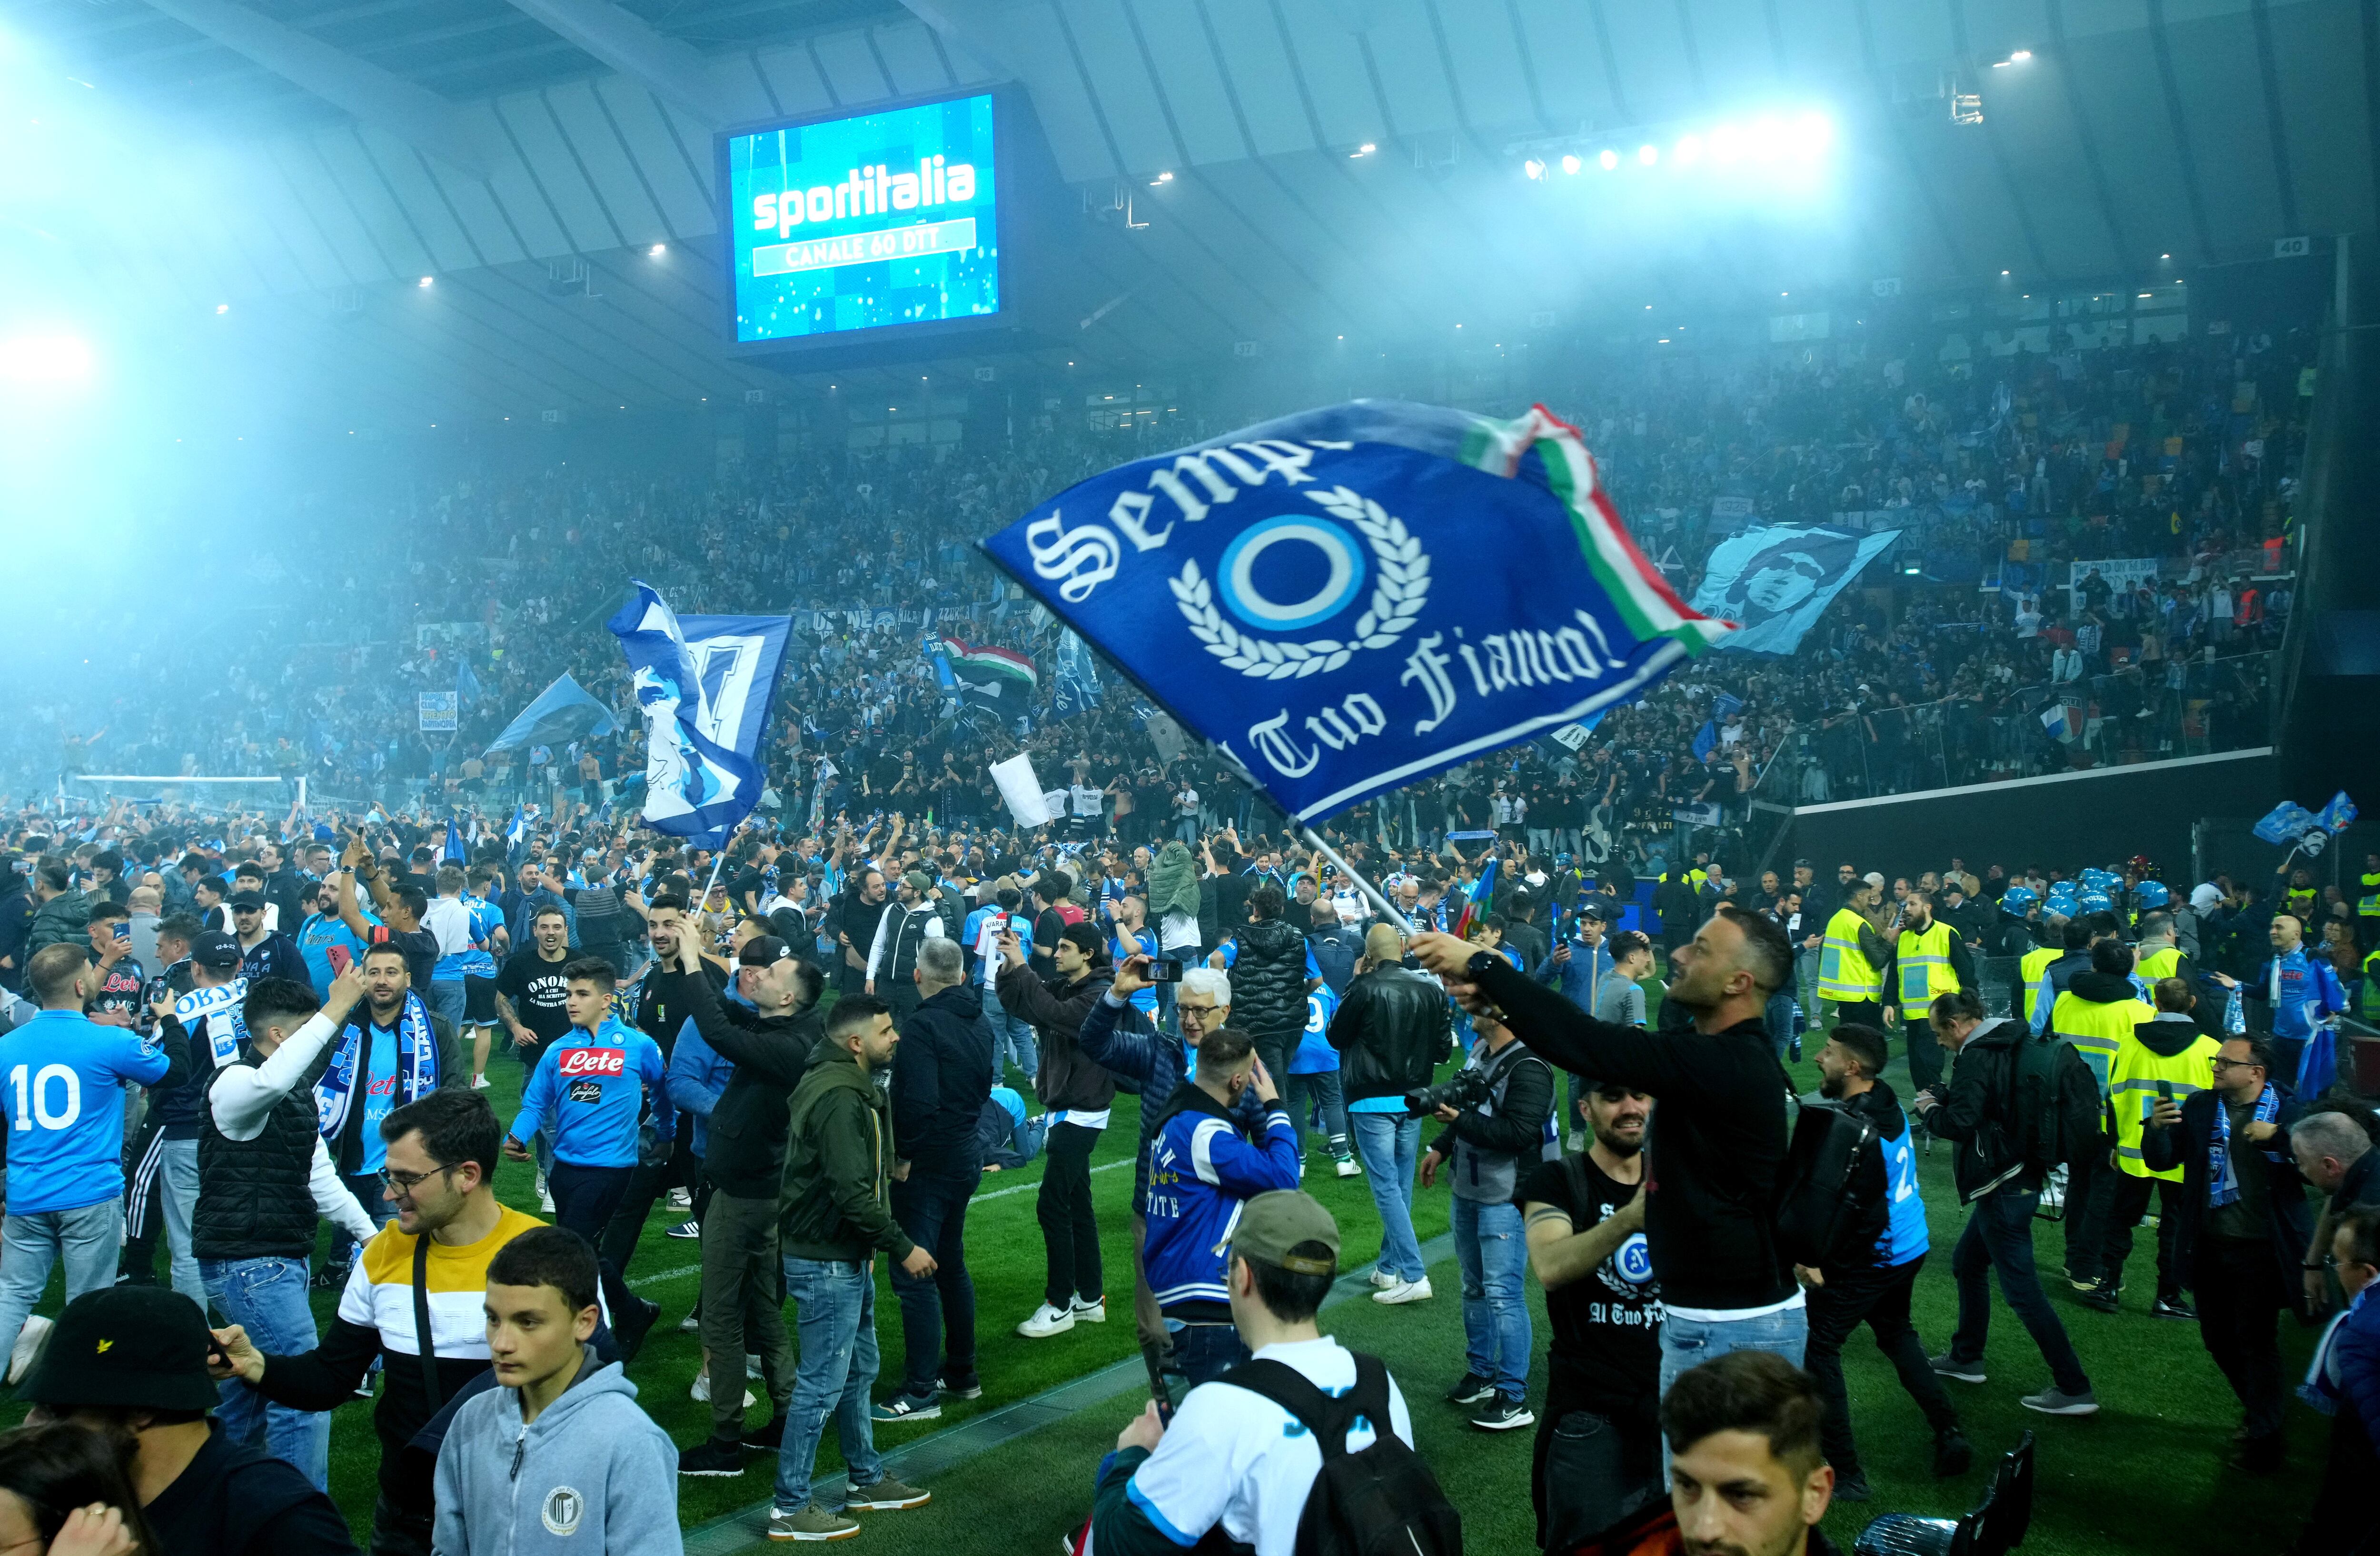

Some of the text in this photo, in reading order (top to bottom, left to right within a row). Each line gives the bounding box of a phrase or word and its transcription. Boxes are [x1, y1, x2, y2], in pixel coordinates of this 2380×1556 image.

[754, 154, 975, 238] sportitalia
[785, 228, 939, 267] CANALE 60 DTT
[2281, 241, 2302, 253] 40
[1878, 282, 1894, 294] 39
[1239, 344, 1251, 354] 37
[979, 370, 990, 379] 36
[750, 392, 759, 401] 35
[1026, 440, 1354, 603] Semp
[813, 610, 872, 631] UDNE
[1400, 609, 1626, 736] Fianco!
[421, 693, 446, 701] NAPOLI
[421, 709, 456, 719] TRENTO
[1249, 693, 1387, 779] Tuo
[305, 933, 335, 945] Mars
[1305, 996, 1324, 1033] 9
[560, 1050, 624, 1074] Lete
[365, 1070, 396, 1095] Let
[10, 1064, 81, 1131] 10
[1146, 1191, 1180, 1218] TATE
[1589, 1302, 1667, 1330] Al Tuo Fia
[566, 1487, 577, 1496] Polo
